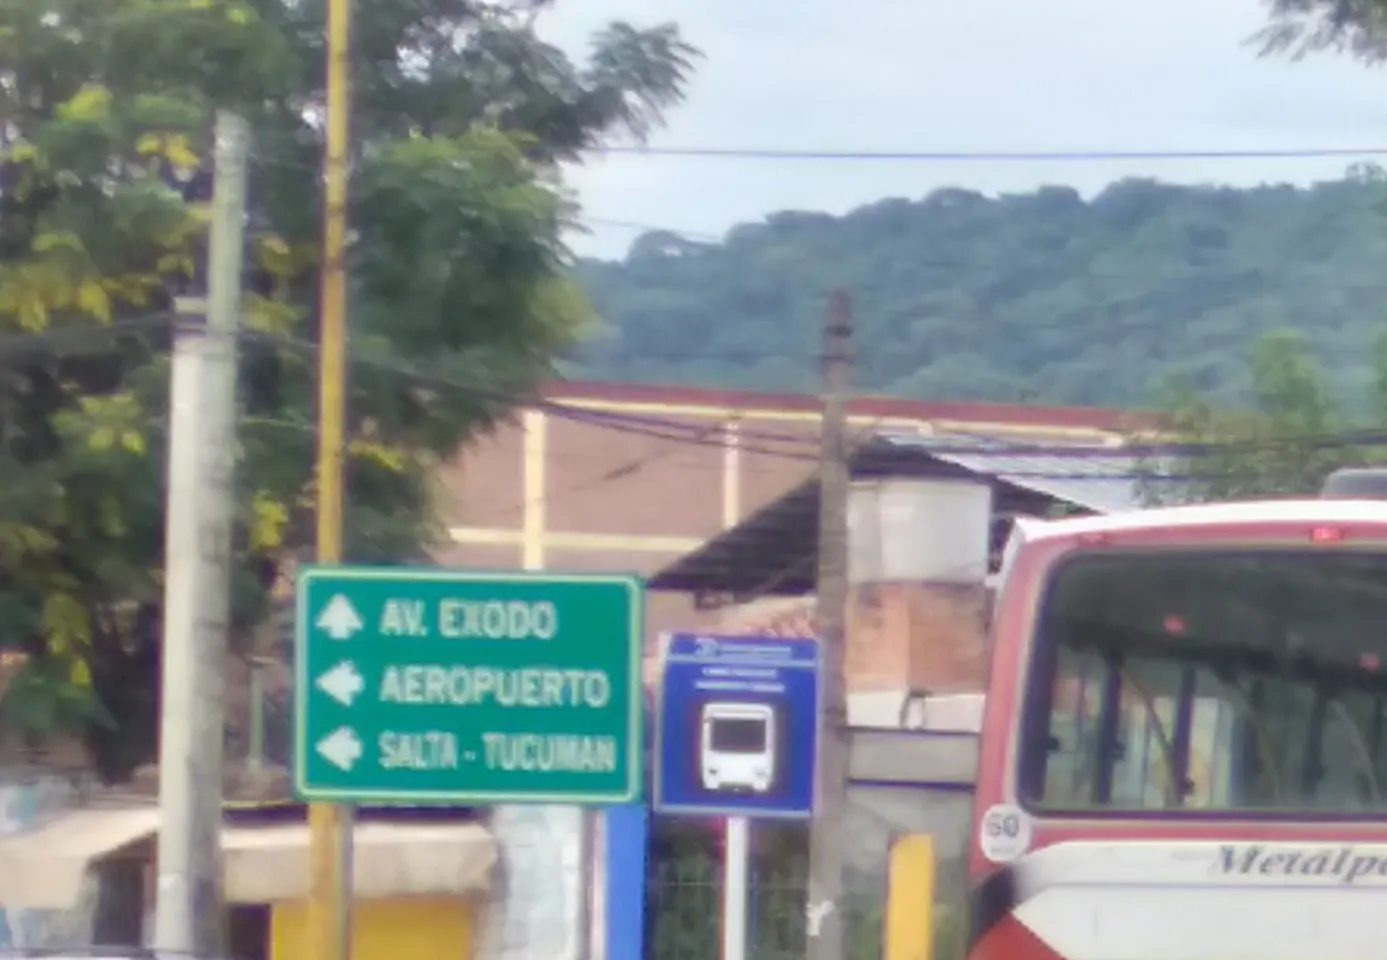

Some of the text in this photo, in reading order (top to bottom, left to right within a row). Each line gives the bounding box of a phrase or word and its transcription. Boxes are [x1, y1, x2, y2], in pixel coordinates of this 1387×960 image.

[379, 598, 558, 640] AV. EXODO
[379, 665, 610, 708] AEROPUERTO
[379, 731, 457, 770] SALTA
[481, 732, 617, 773] TUCUMAN
